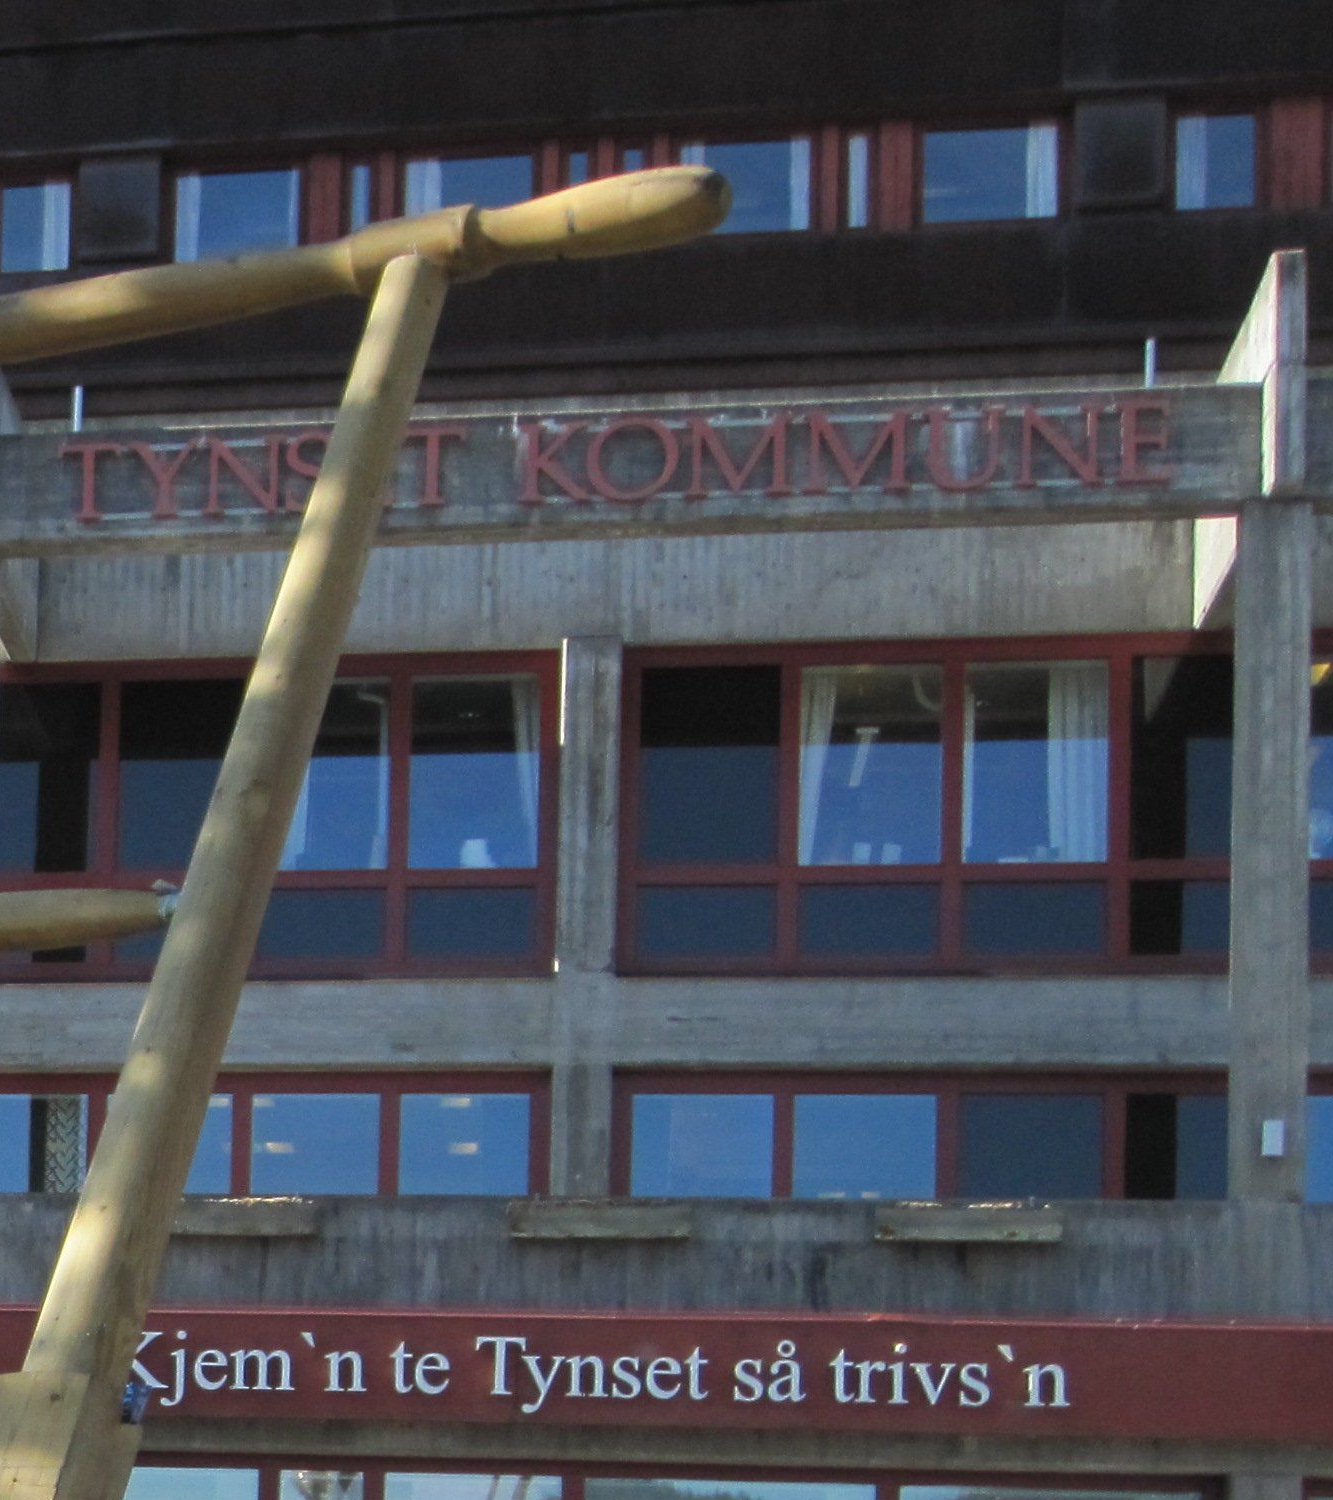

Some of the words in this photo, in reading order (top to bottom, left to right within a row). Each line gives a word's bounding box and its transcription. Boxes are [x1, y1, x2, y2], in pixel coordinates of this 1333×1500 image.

[57, 425, 471, 523] TYNST
[517, 401, 1173, 505] KOMMUNE
[389, 1341, 451, 1395] te
[475, 1336, 710, 1414] Tynset
[733, 1339, 807, 1402] så
